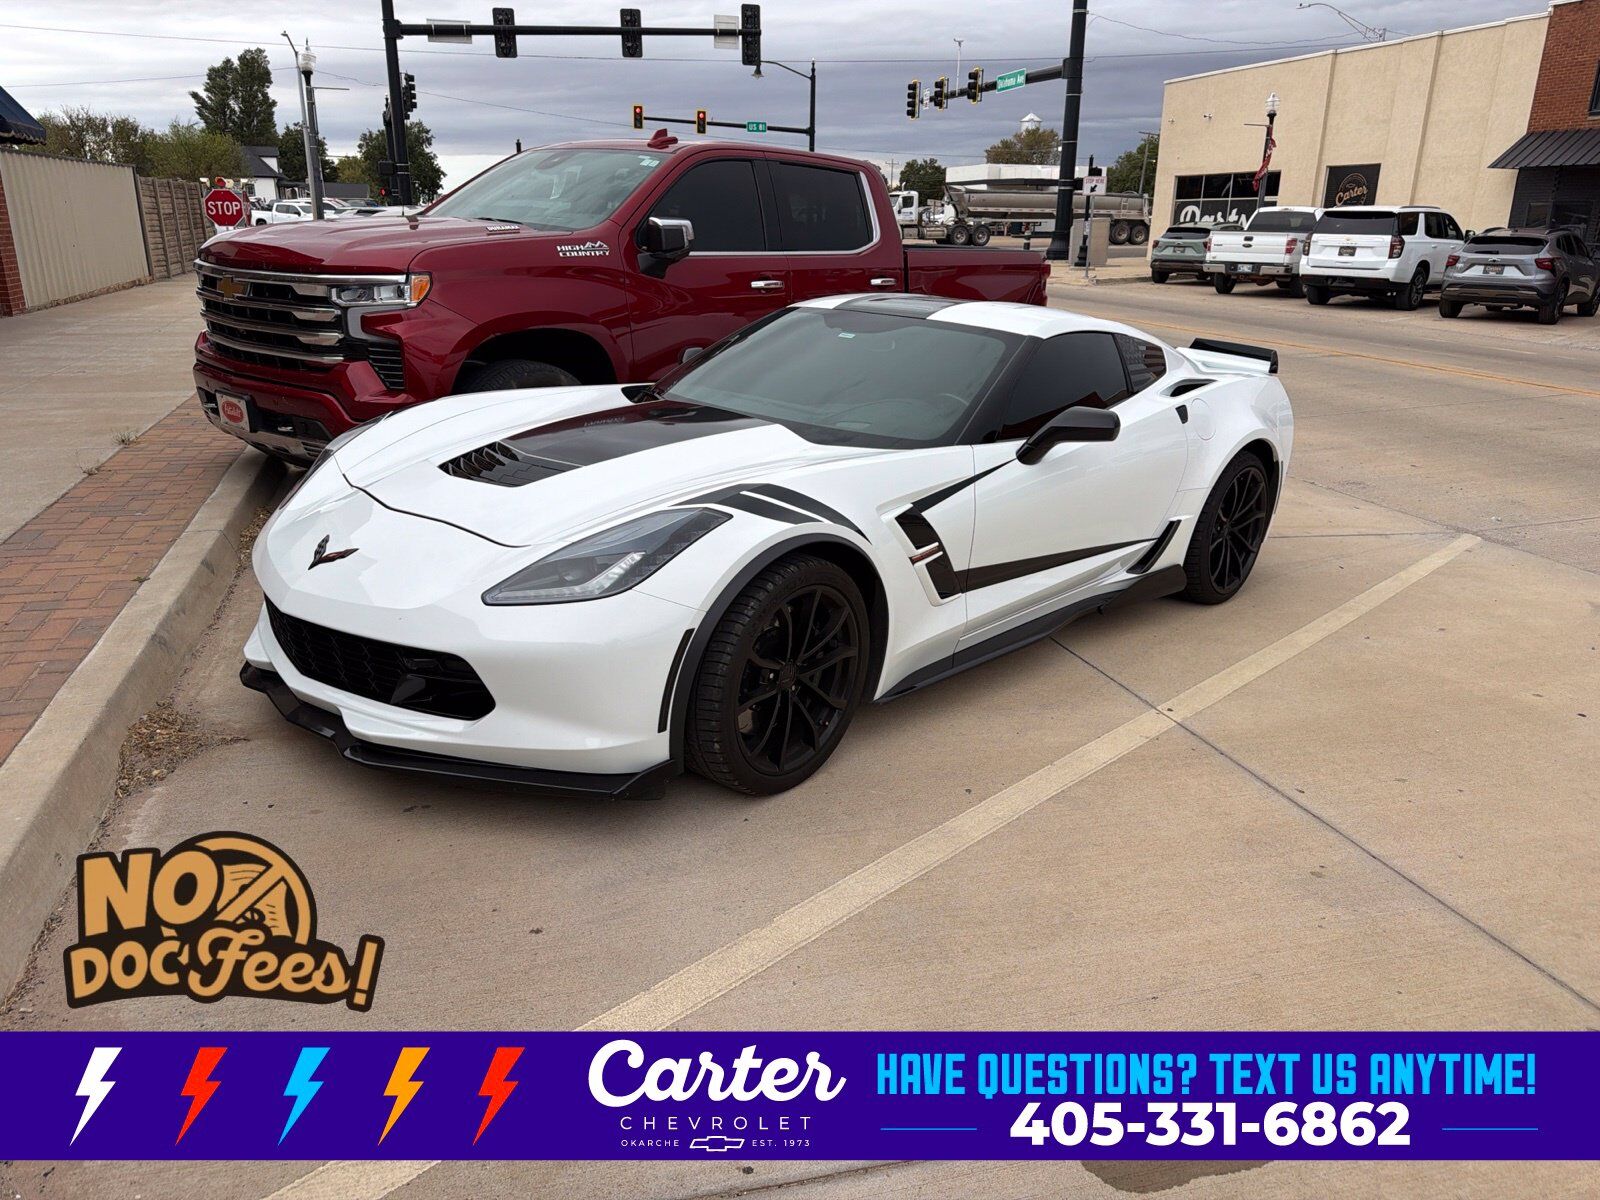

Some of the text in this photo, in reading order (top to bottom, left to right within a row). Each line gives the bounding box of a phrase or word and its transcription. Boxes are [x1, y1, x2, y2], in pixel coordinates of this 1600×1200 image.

[1335, 185, 1368, 206] Carter
[207, 201, 241, 216] STOP
[556, 244, 584, 252] HIGH
[559, 250, 610, 258] COUNTRY
